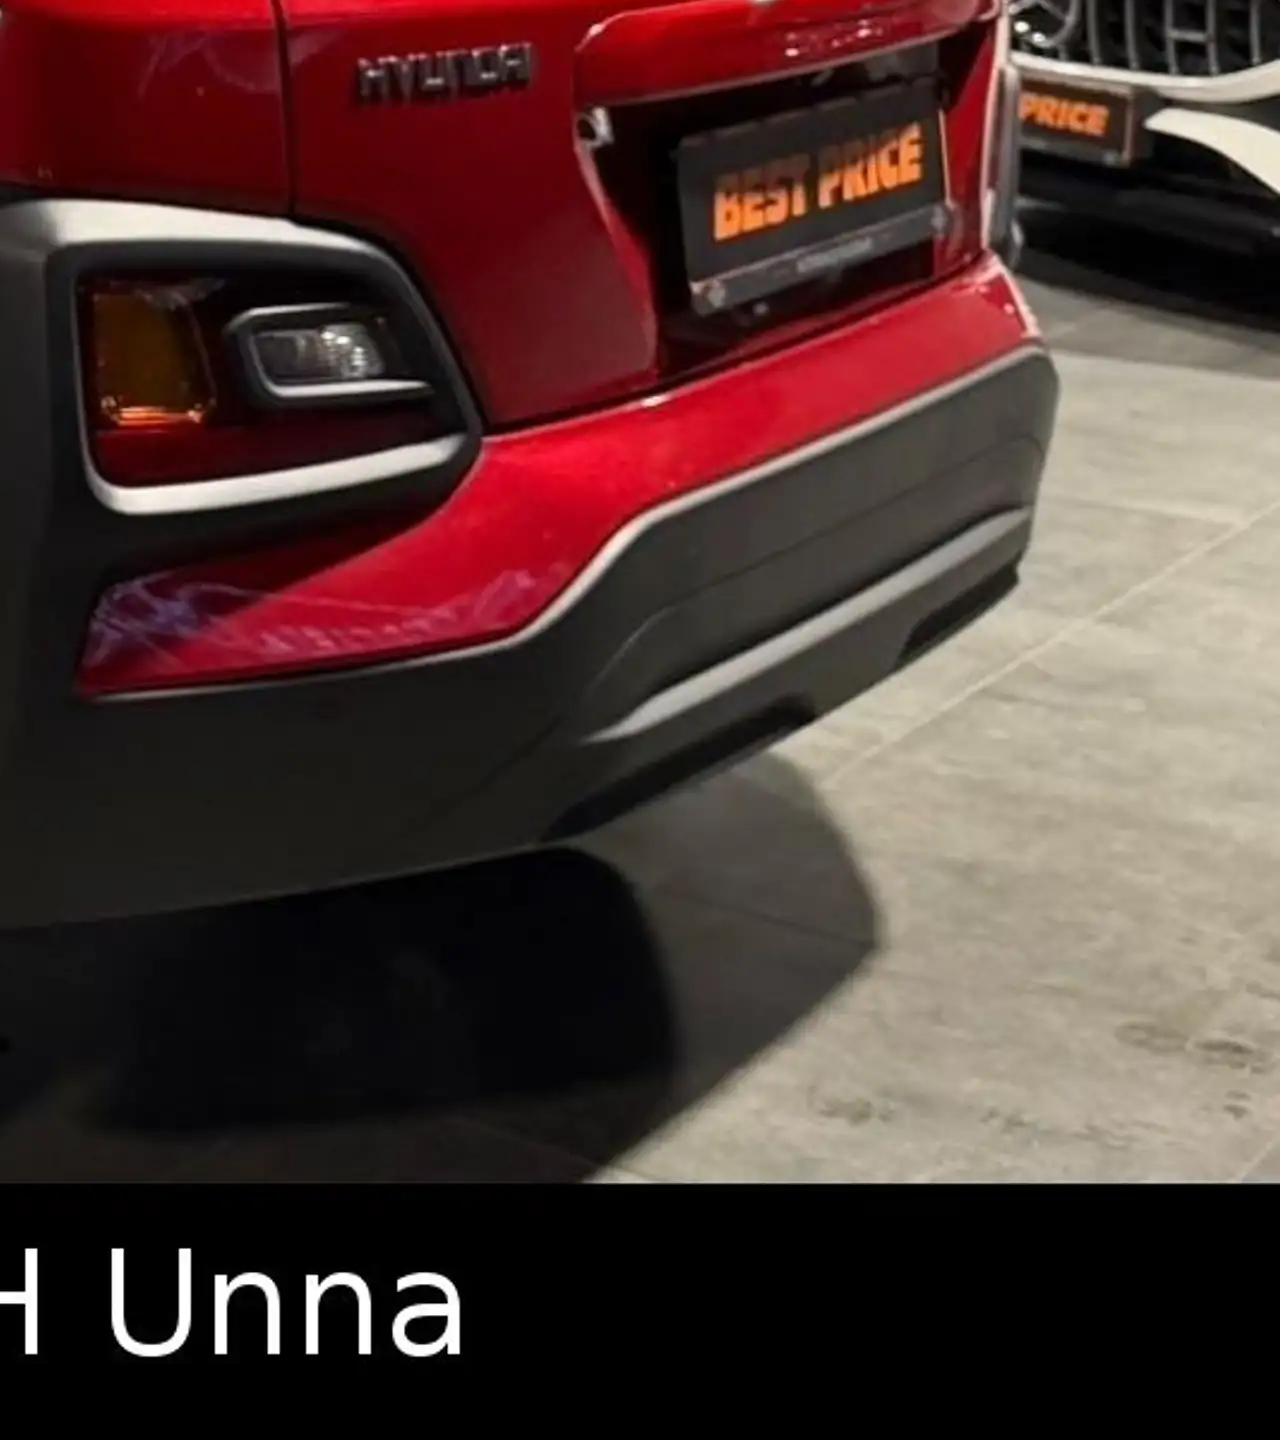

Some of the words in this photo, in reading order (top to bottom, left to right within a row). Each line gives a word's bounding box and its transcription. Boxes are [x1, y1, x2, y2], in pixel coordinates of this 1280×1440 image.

[1018, 91, 1109, 138] PRICE
[712, 154, 809, 242] BEST
[816, 121, 923, 209] PRICE
